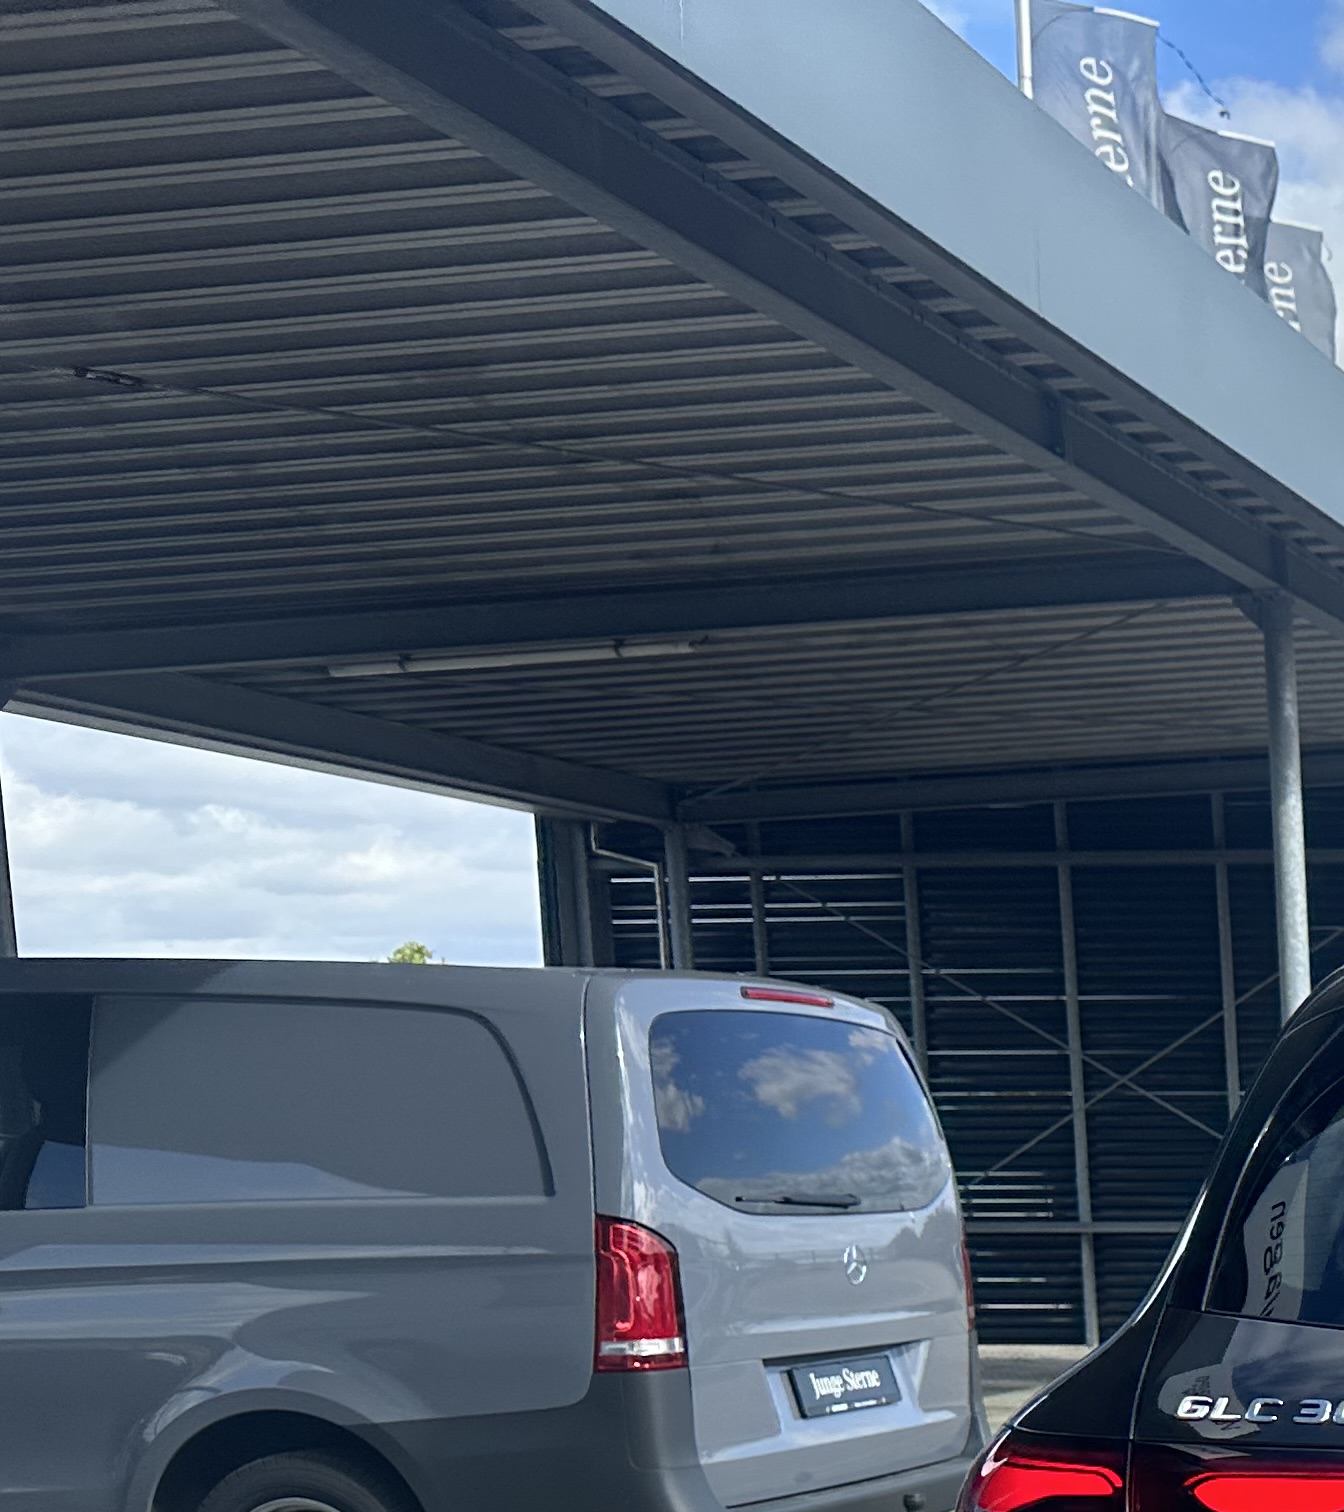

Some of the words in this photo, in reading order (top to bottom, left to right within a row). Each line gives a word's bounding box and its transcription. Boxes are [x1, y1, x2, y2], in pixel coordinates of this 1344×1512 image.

[1080, 57, 1133, 187] erne
[1207, 169, 1249, 285] erne
[808, 1372, 845, 1400] Junge
[842, 1367, 881, 1391] Sterne
[1176, 1396, 1284, 1421] GLC
